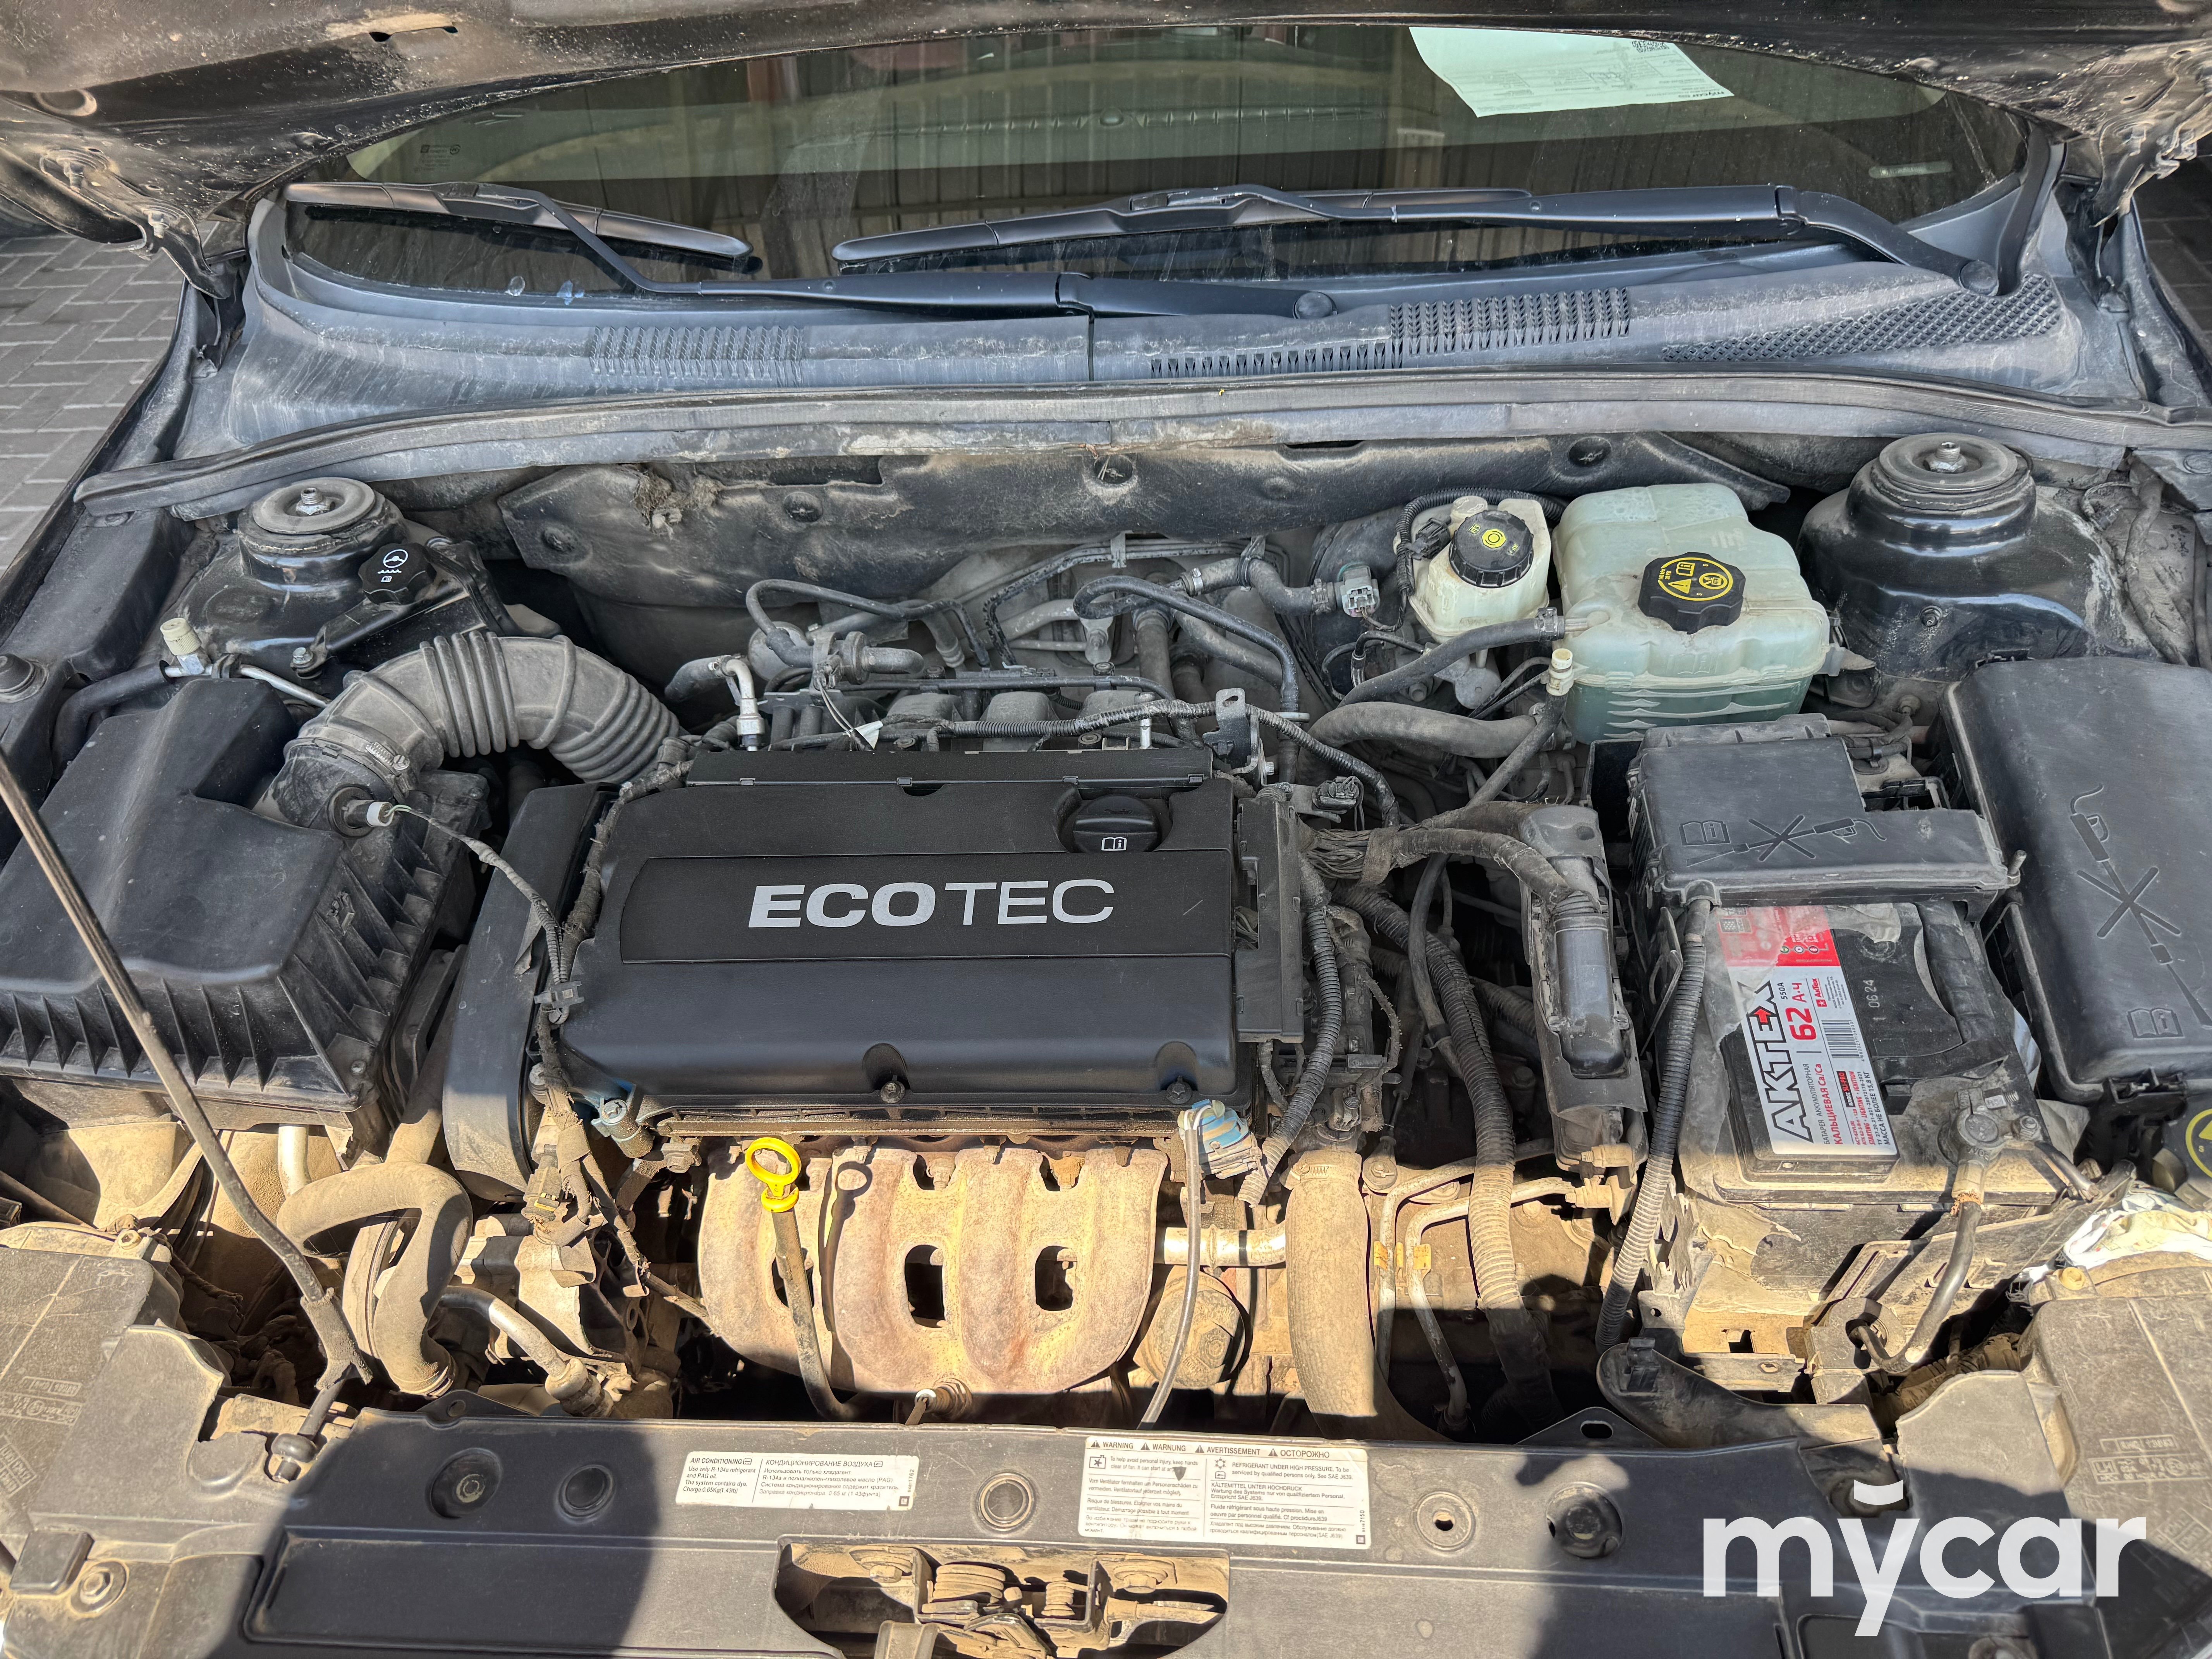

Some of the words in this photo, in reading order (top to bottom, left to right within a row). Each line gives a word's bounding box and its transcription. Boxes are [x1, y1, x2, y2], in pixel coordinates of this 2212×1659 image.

[748, 878, 1115, 928] ECOTEC
[1784, 1007, 1818, 1040] 62
[1802, 1063, 1823, 1116] АККУМУЛЯТОРНАЯ
[1838, 1072, 1850, 1091] SLI-PRO
[1848, 1070, 1860, 1091] IGNITION
[1865, 1079, 1875, 1091] 15,8
[1844, 1092, 1854, 1106] класс
[1855, 1096, 1868, 1118] LIGHTING
[1869, 1092, 1881, 1112] БОЛЕЕ
[1819, 1088, 1844, 1144] КАЛЬЦИЕВАЯ
[1875, 1113, 1884, 1121] НЕ
[1817, 1119, 1831, 1144] БАТАРЕЯ
[1863, 1123, 1876, 1145] STARTING
[1878, 1122, 1891, 1145] МАССА
[1103, 1441, 1133, 1449] WARNING
[1152, 1443, 1186, 1451] WARNUNG
[1206, 1446, 1260, 1455] AVERTISSEMENT
[1279, 1449, 1330, 1458] ОСТОРОЖНО
